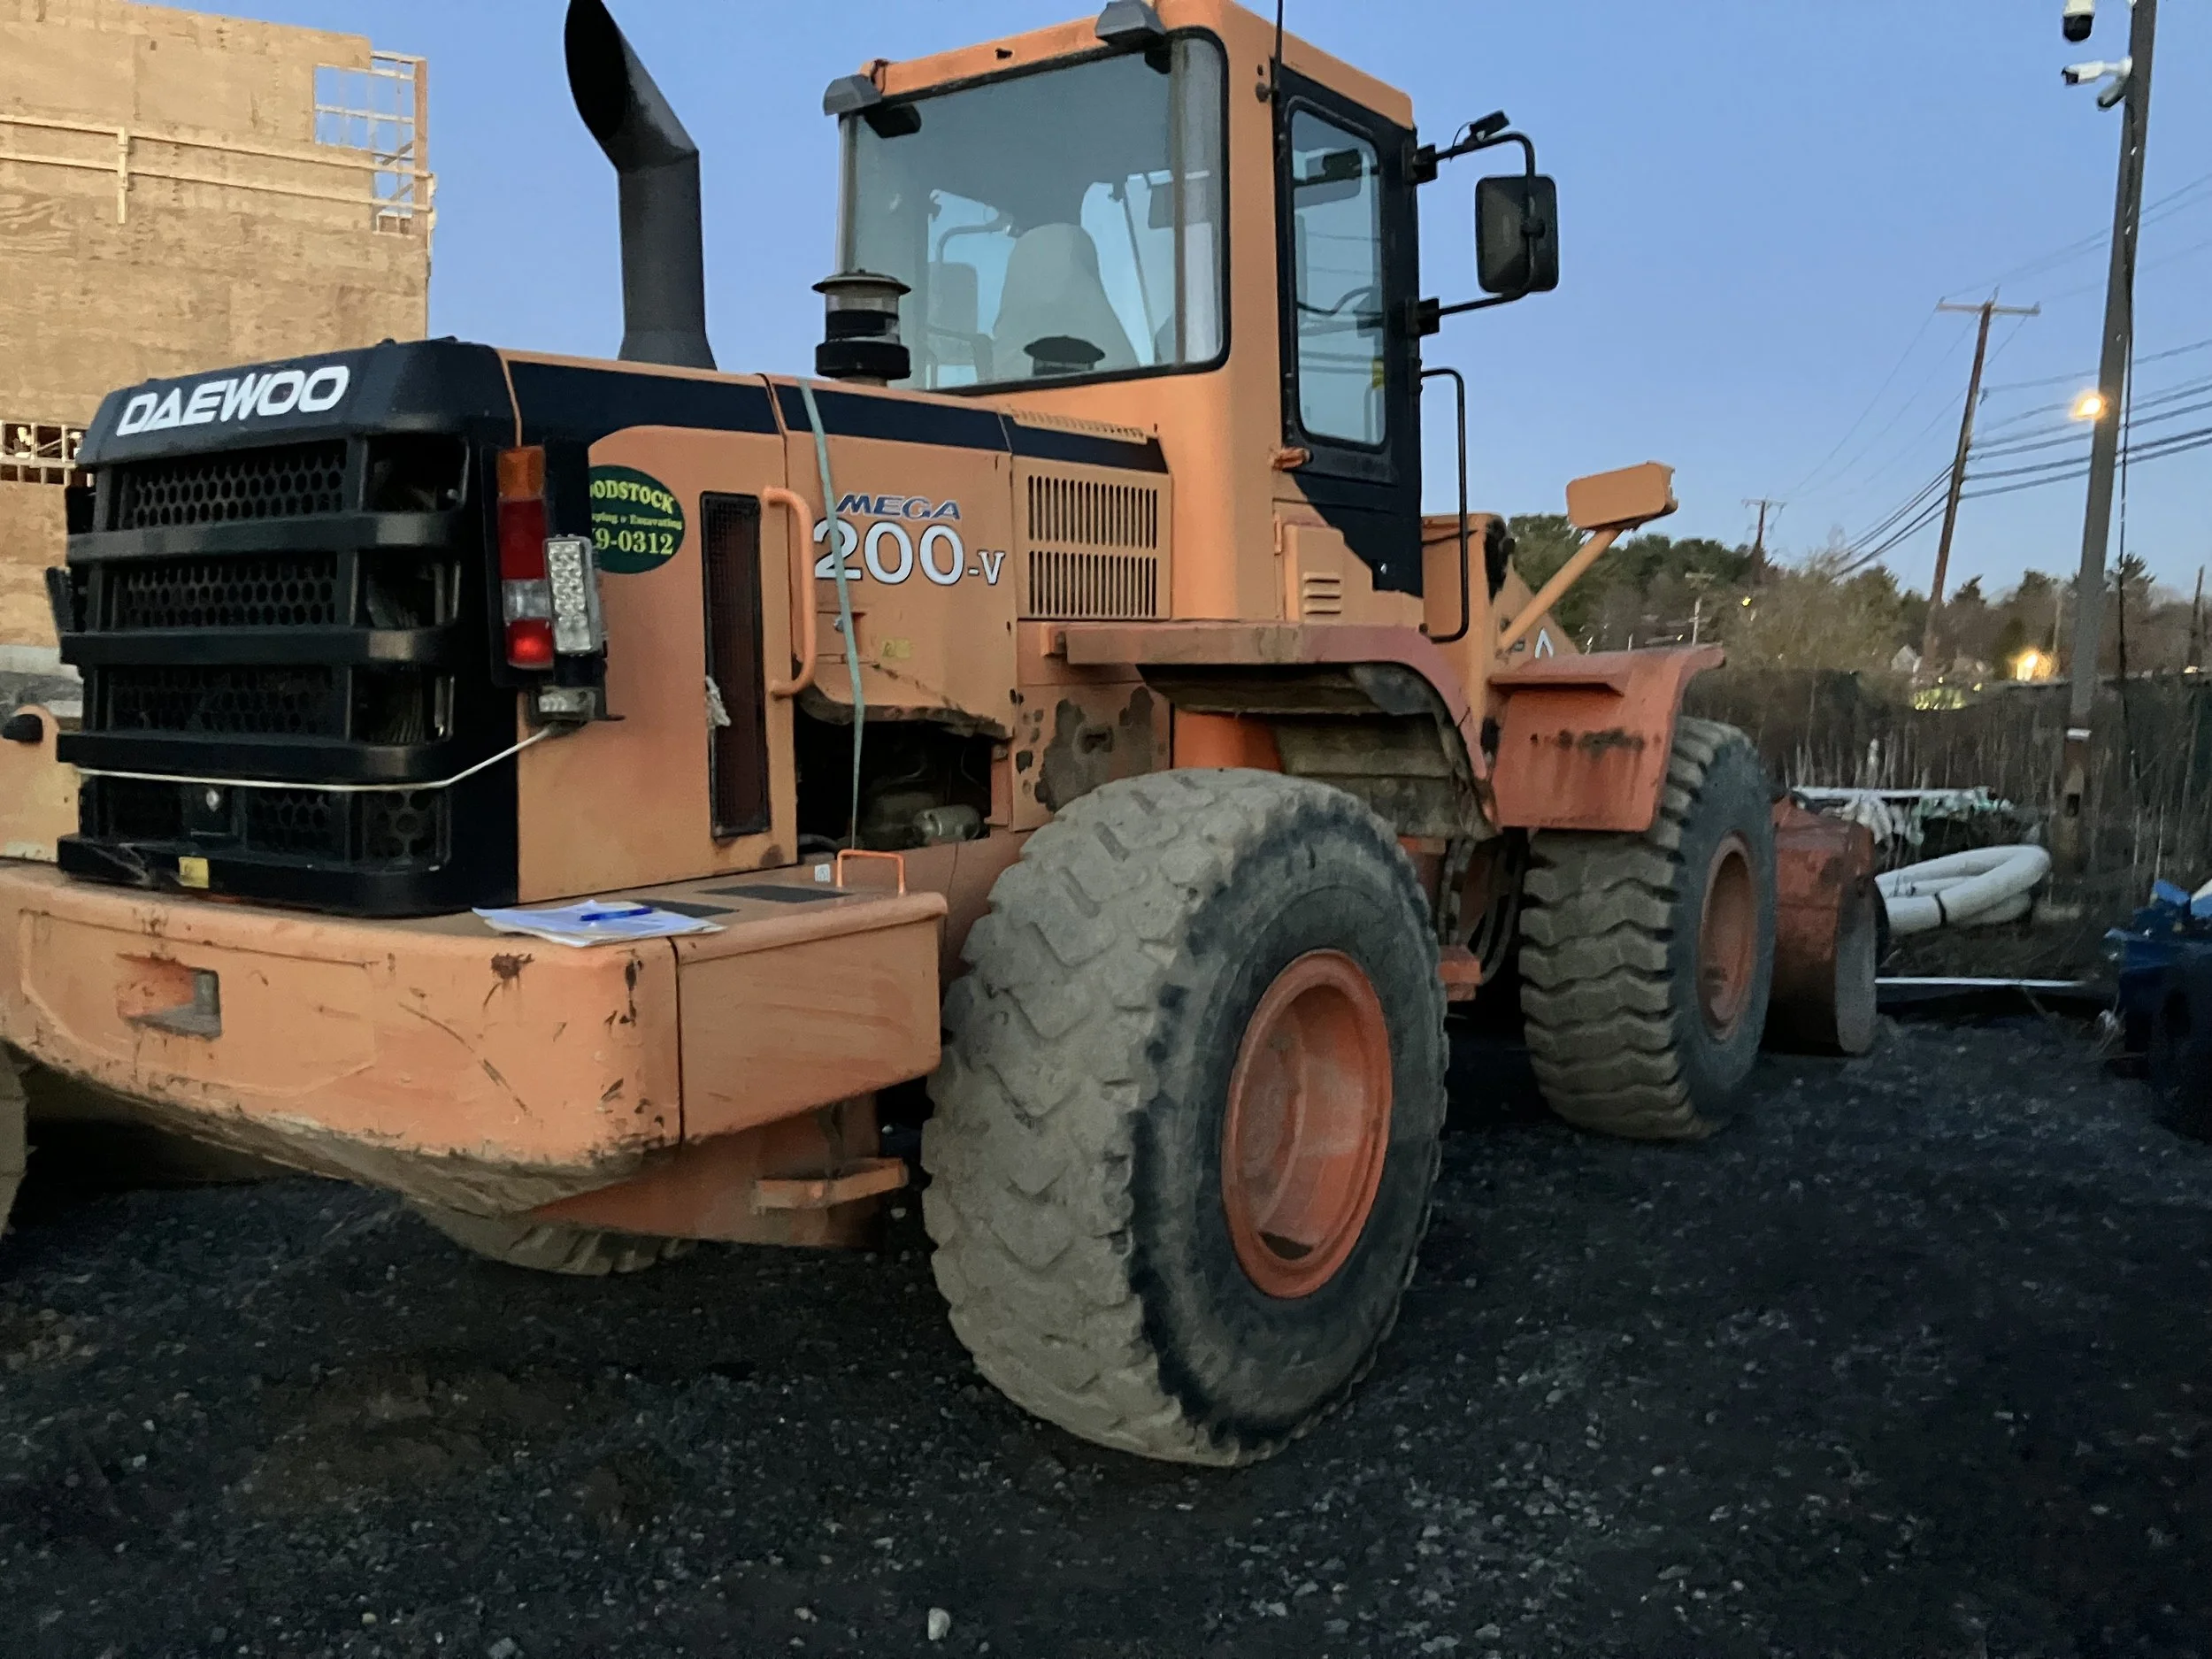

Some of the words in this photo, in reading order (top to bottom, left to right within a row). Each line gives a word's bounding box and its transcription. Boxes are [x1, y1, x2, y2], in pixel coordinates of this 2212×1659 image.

[116, 365, 350, 437] DAEWOO
[835, 493, 962, 521] MEGA
[592, 527, 674, 554] 9-0312
